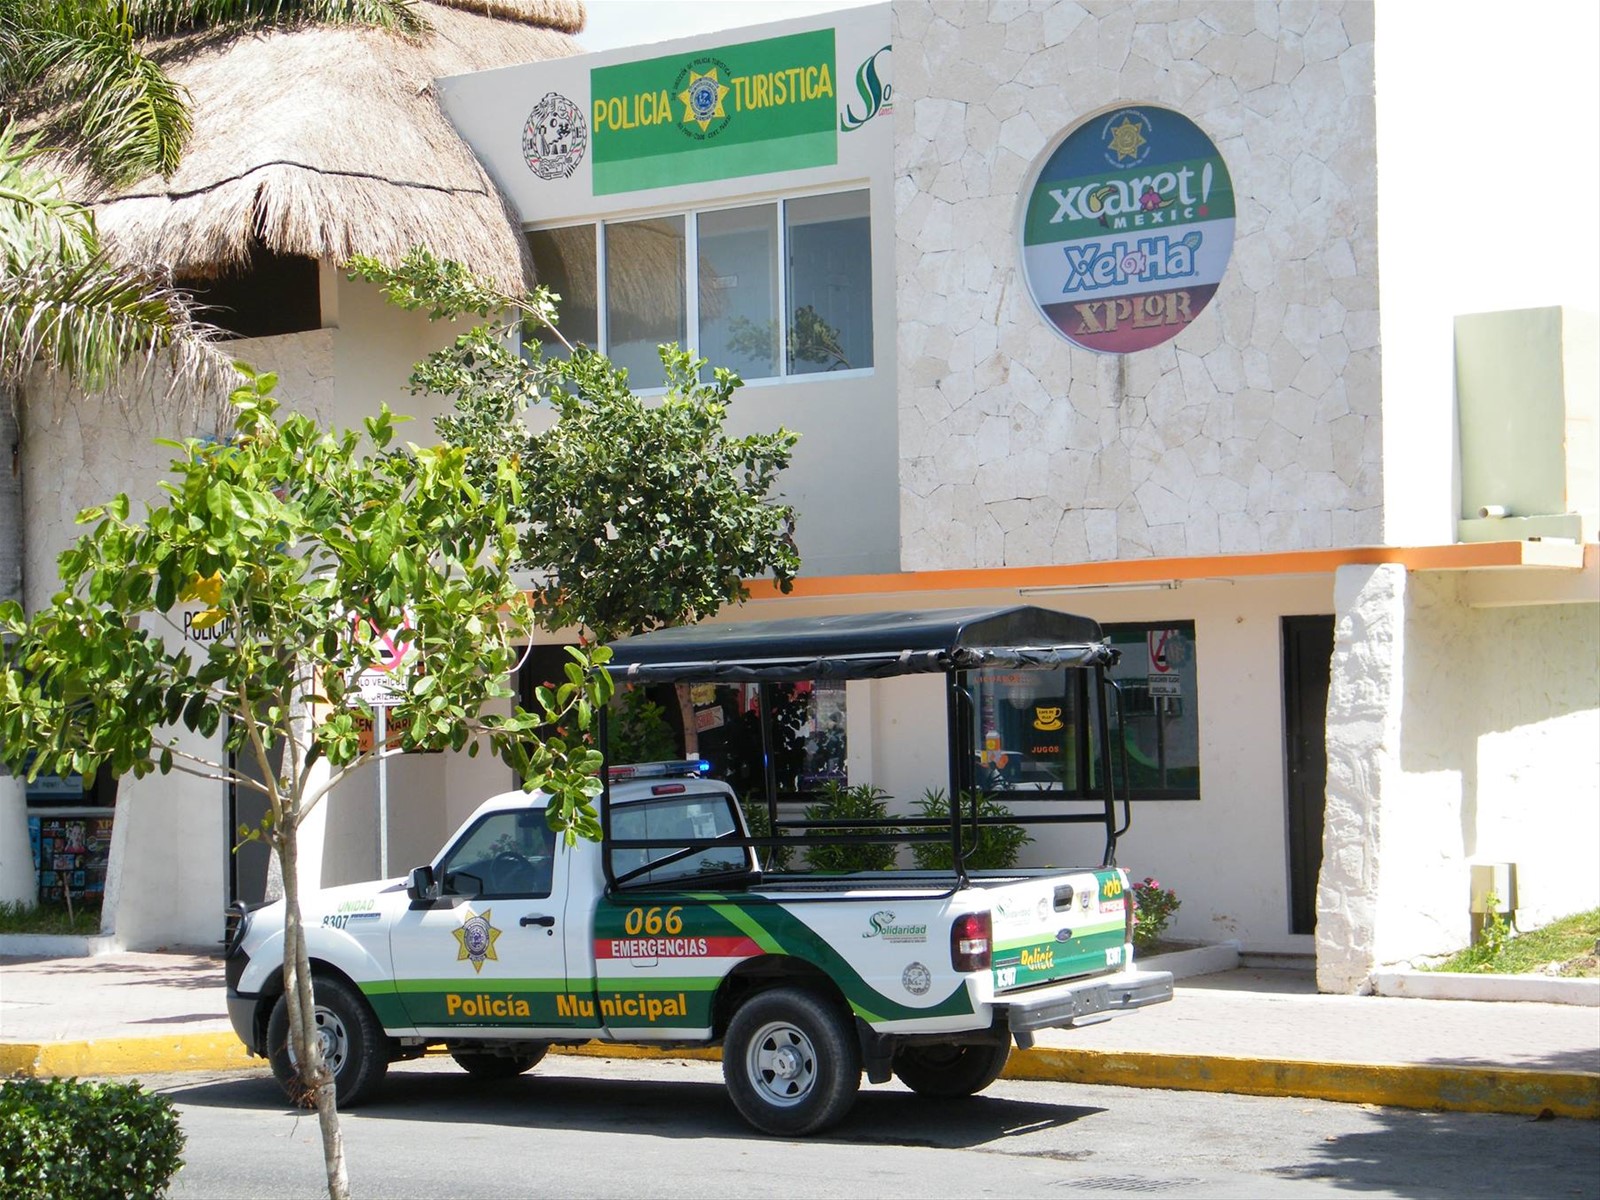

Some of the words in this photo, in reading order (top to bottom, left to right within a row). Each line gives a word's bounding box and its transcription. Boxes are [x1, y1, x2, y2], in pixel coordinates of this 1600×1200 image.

[593, 89, 673, 133] POLICIA
[731, 63, 834, 113] TURISTICA
[1073, 291, 1193, 336] XPLOR
[1031, 745, 1060, 753] JUGOS
[337, 899, 375, 912] UNIDAD
[320, 914, 349, 930] 8307
[625, 906, 683, 935] 066
[862, 910, 927, 938] Solidaridad
[611, 938, 707, 957] EMERGENCIAS
[446, 993, 531, 1018] Policía
[556, 993, 687, 1021] Municipal
